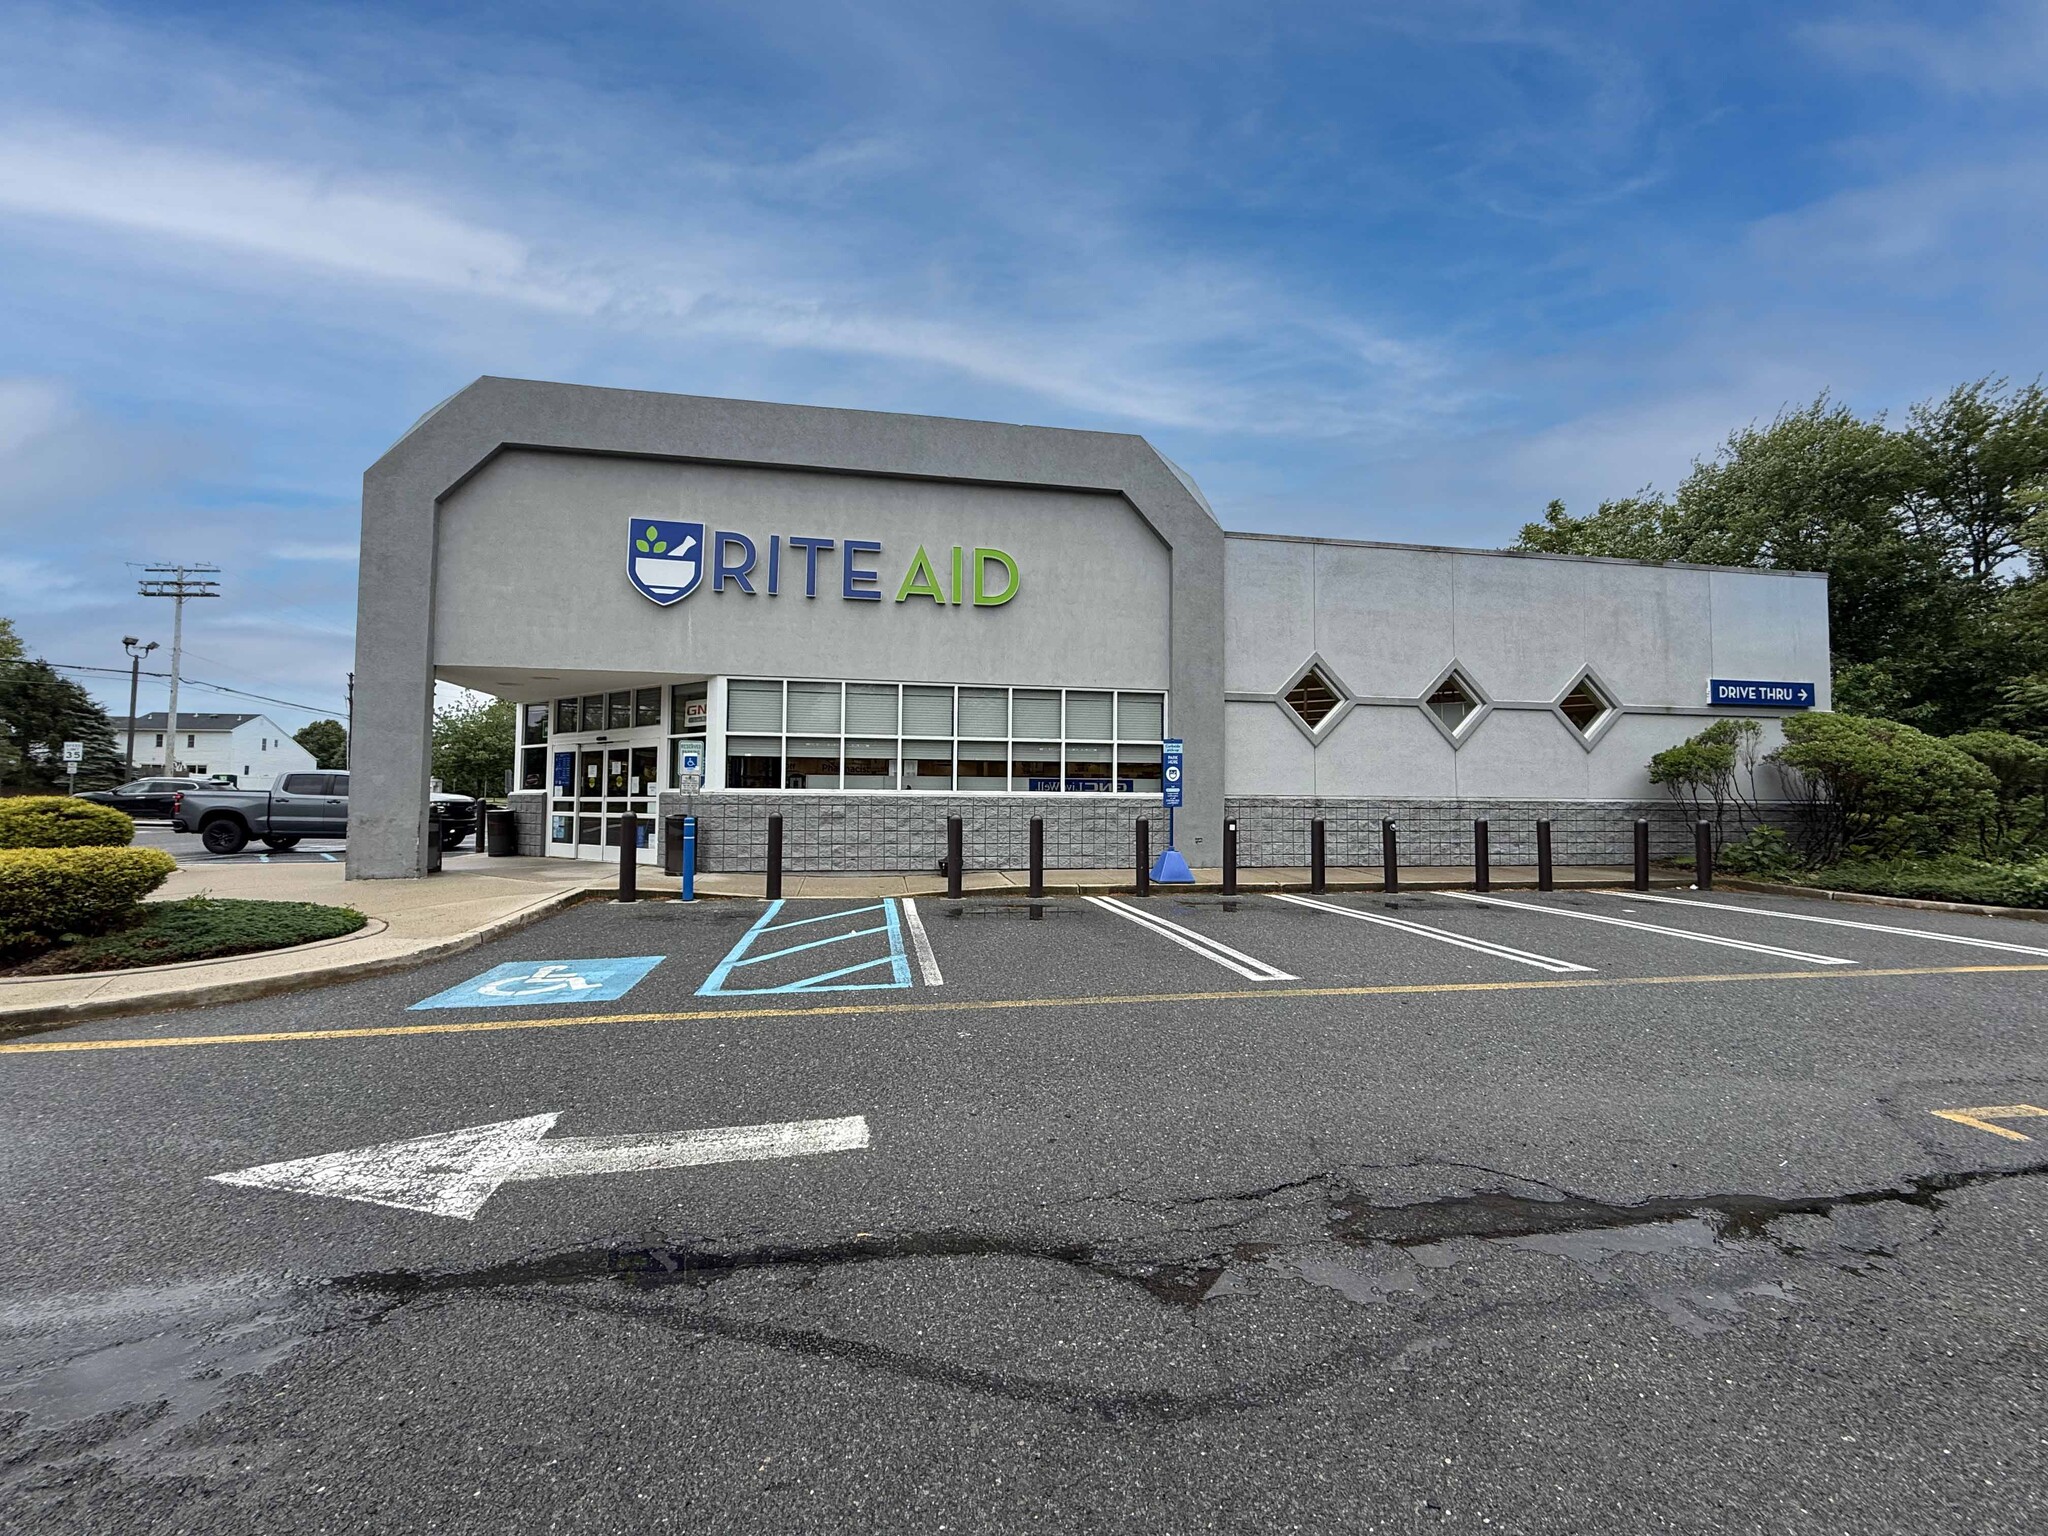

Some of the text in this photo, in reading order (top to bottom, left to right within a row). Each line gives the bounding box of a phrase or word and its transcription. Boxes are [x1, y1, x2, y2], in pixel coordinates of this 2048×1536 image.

[712, 530, 1020, 606] RITE AID
[1719, 685, 1793, 701] DRIVE THRU
[687, 704, 706, 716] GN
[821, 763, 871, 774] Phamacist
